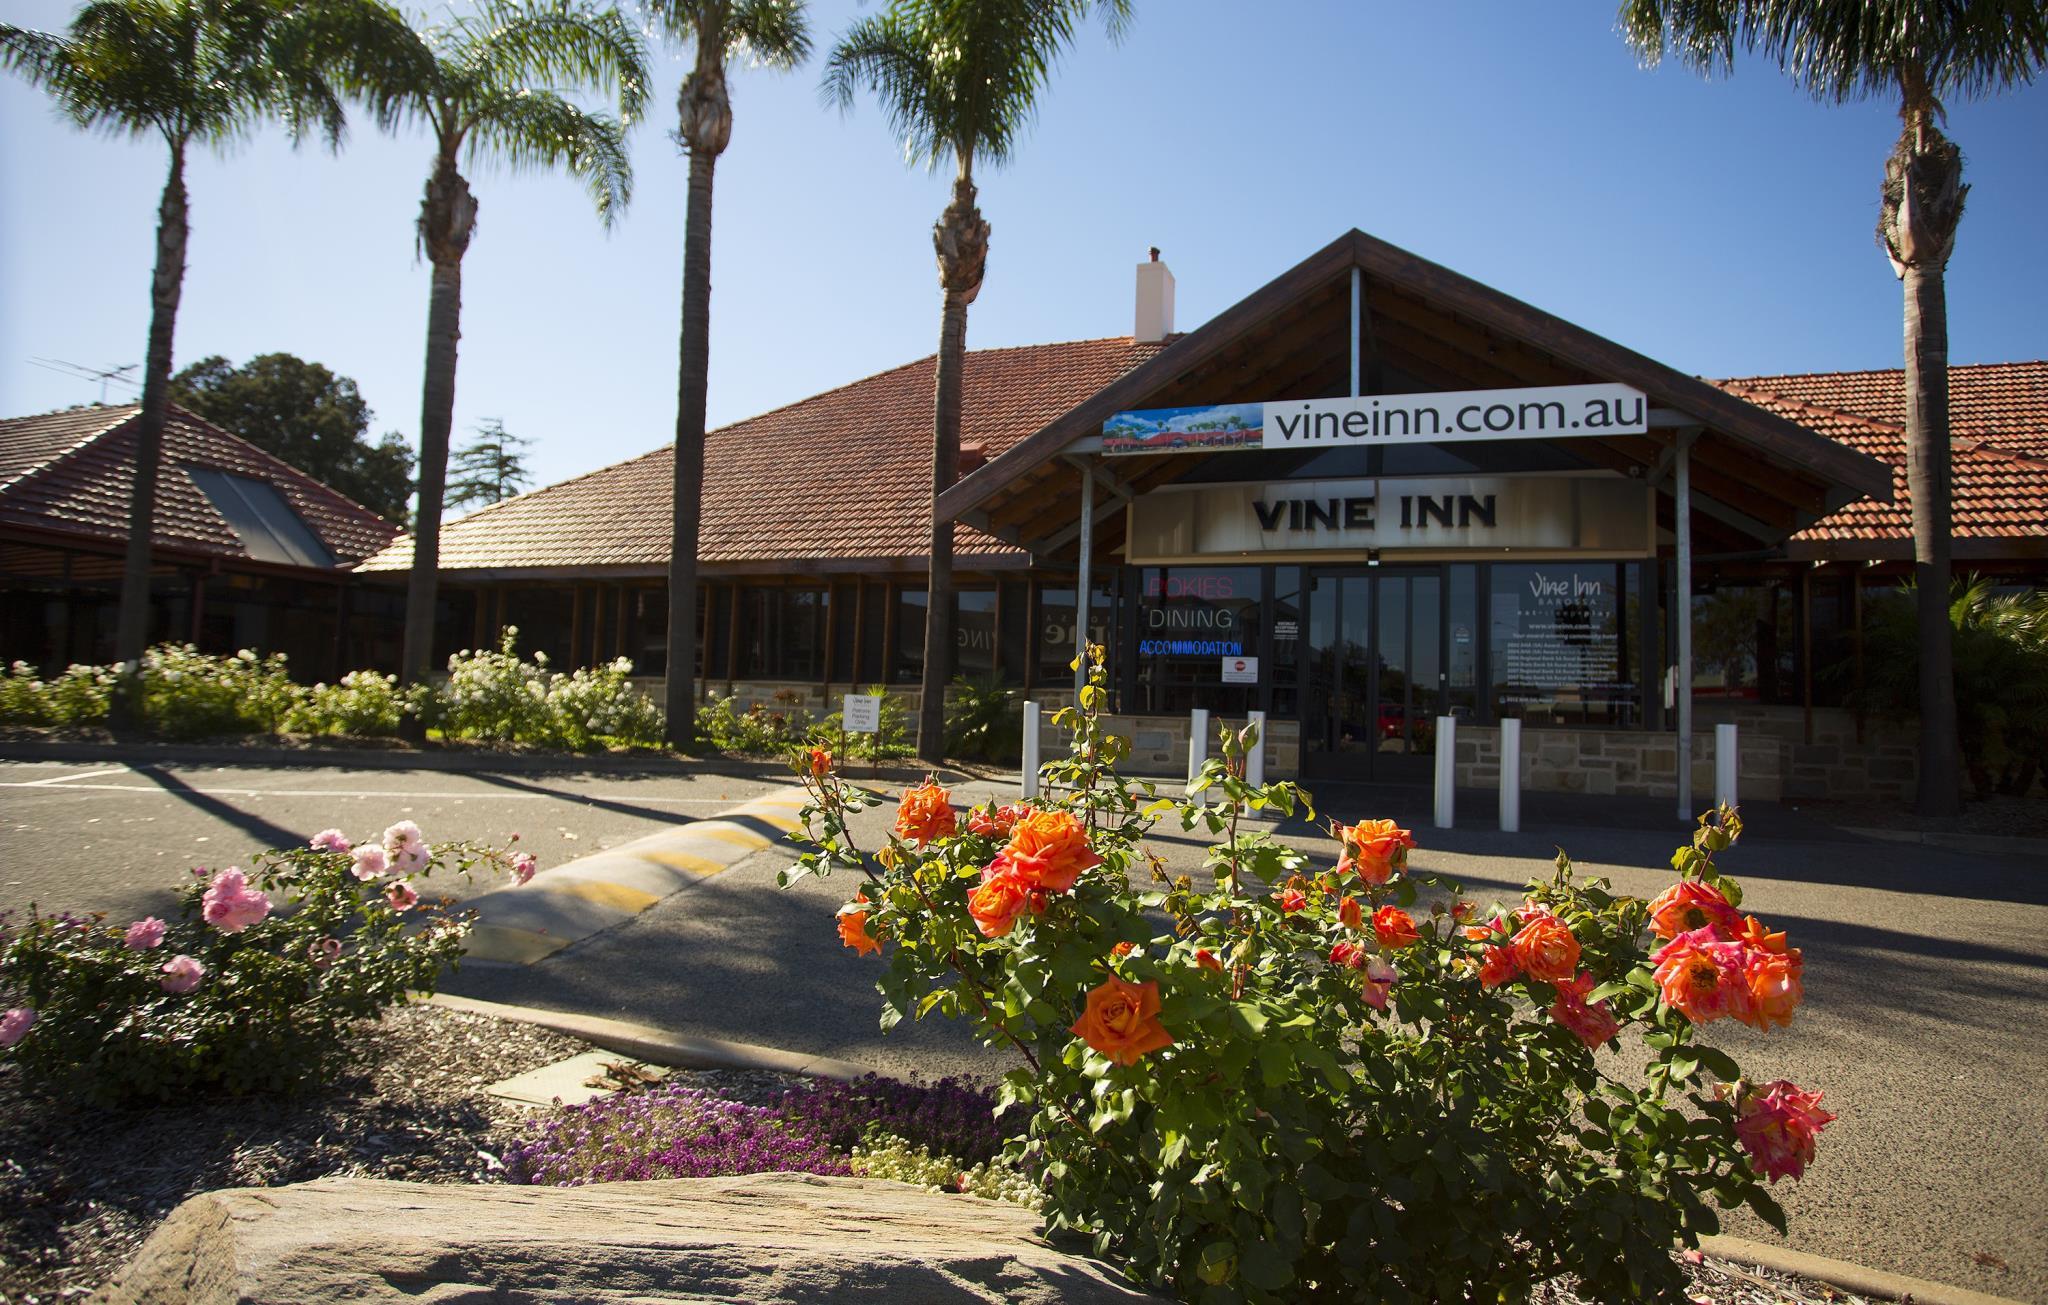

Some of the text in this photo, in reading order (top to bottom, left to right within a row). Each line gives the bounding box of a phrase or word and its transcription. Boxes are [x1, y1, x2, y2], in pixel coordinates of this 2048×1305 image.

[1274, 397, 1644, 440] vineinn.com.au
[1252, 495, 1497, 530] VINE INN
[1148, 576, 1233, 599] POKIES
[1529, 572, 1600, 598] Vine Inn
[1150, 609, 1232, 628] DINING
[1139, 640, 1243, 656] ACCOMMODATION
